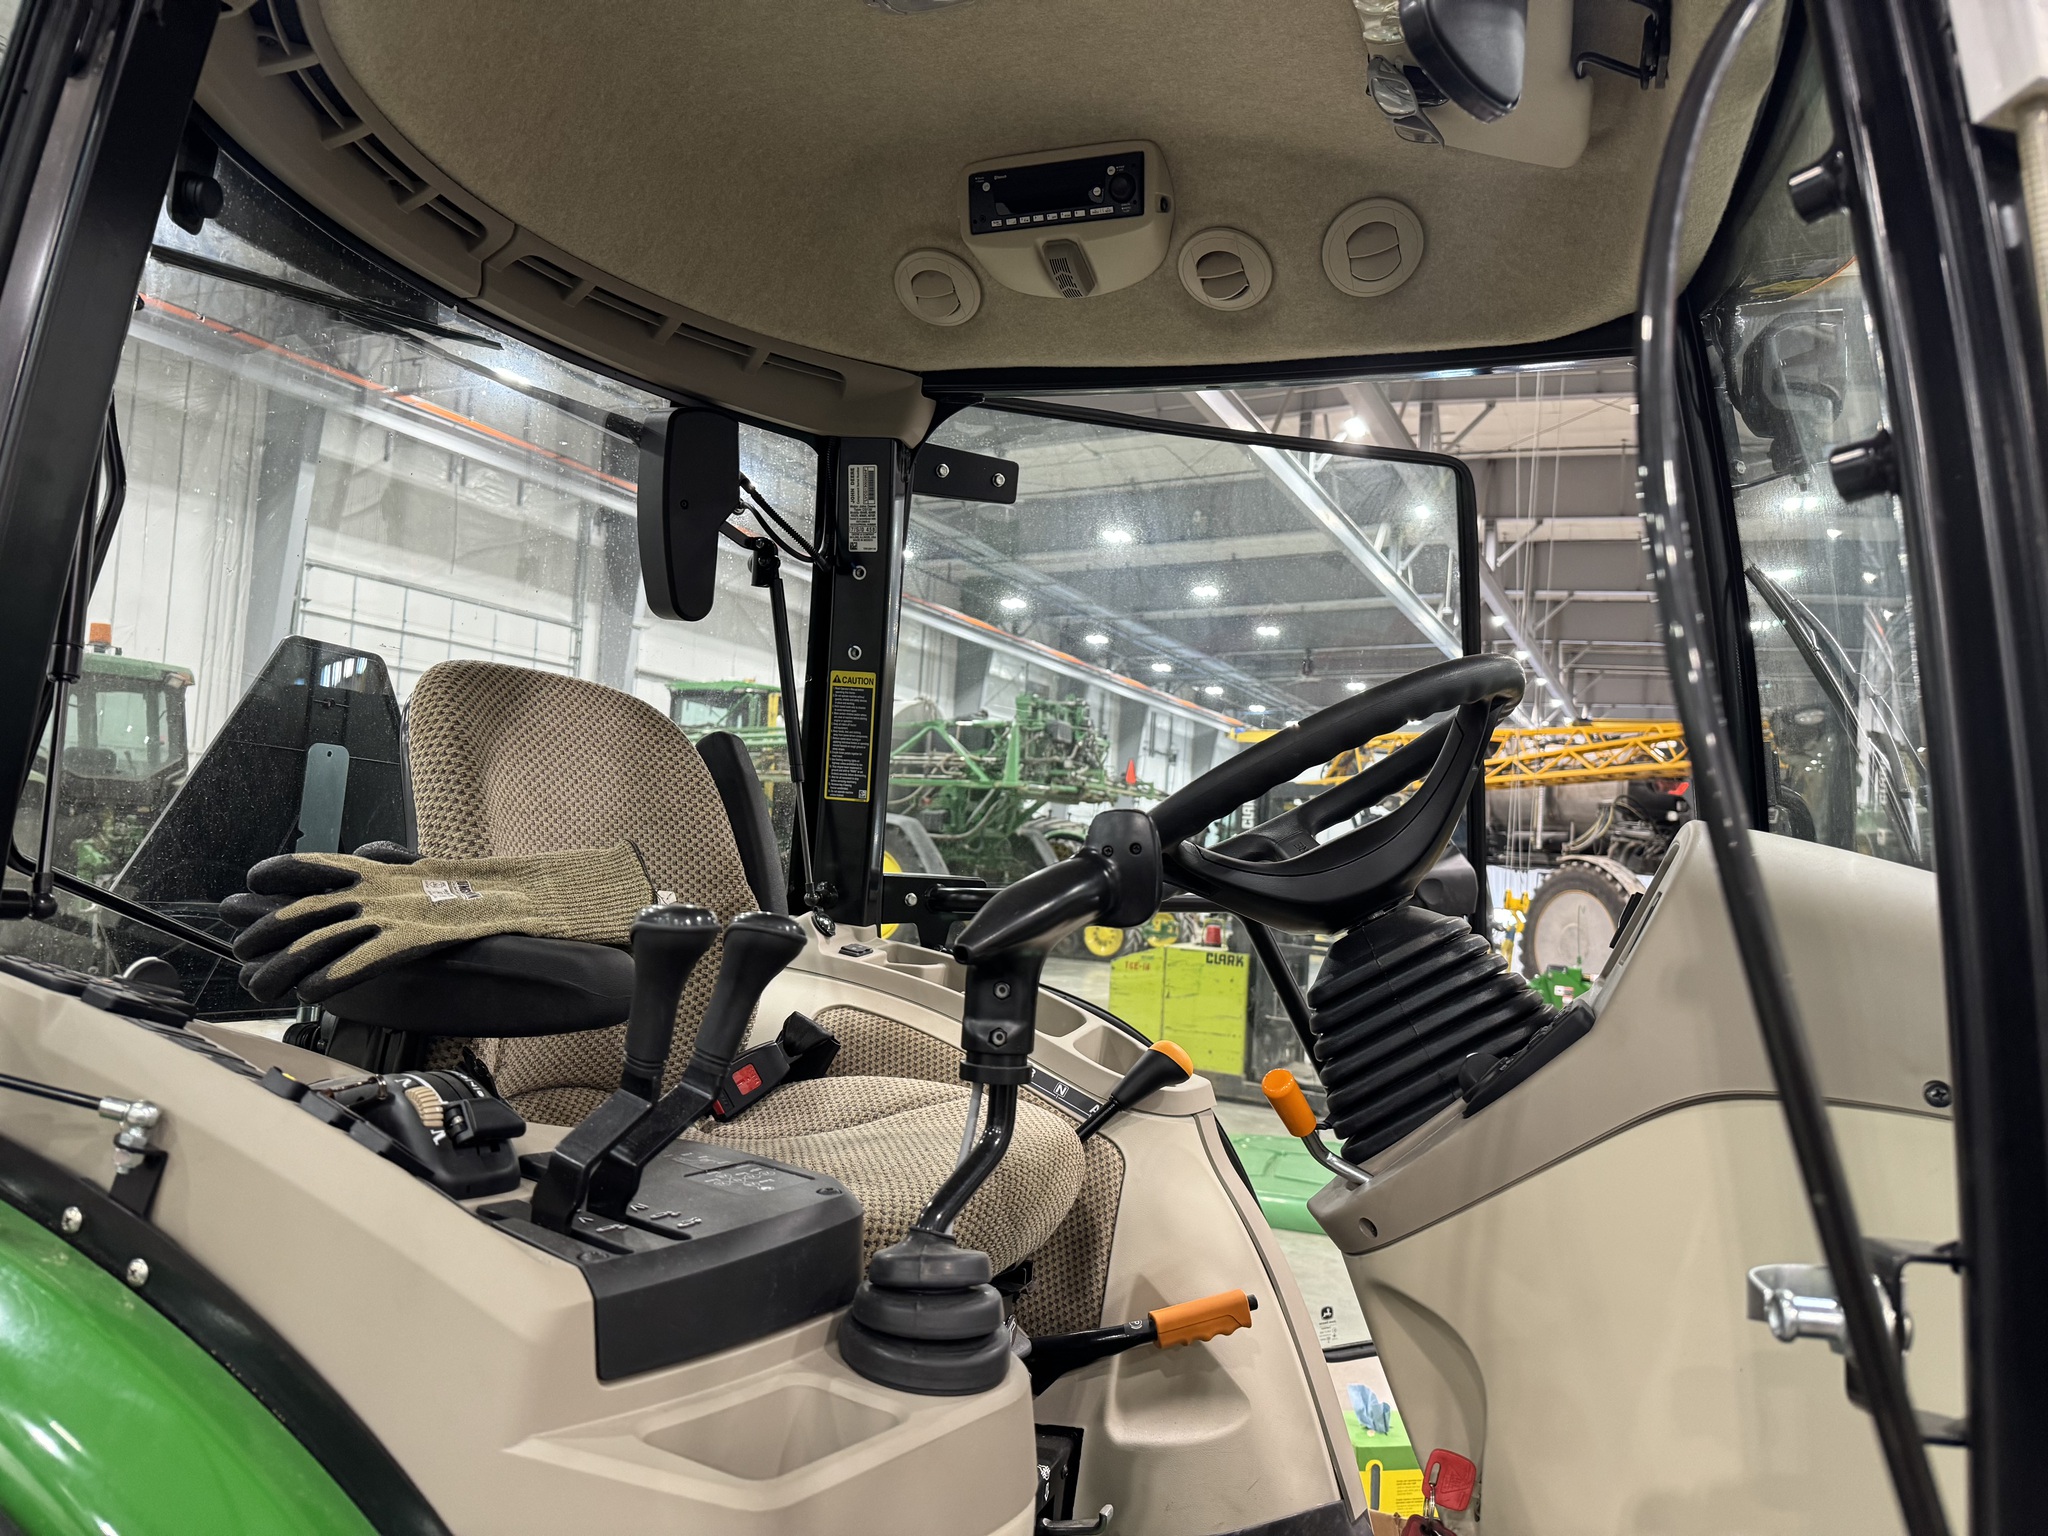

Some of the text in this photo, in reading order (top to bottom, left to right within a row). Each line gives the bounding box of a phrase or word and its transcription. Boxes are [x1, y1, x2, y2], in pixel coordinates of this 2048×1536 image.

[842, 676, 875, 686] CAUTION
[1206, 952, 1244, 967] CLARK
[1055, 1084, 1067, 1096] N
